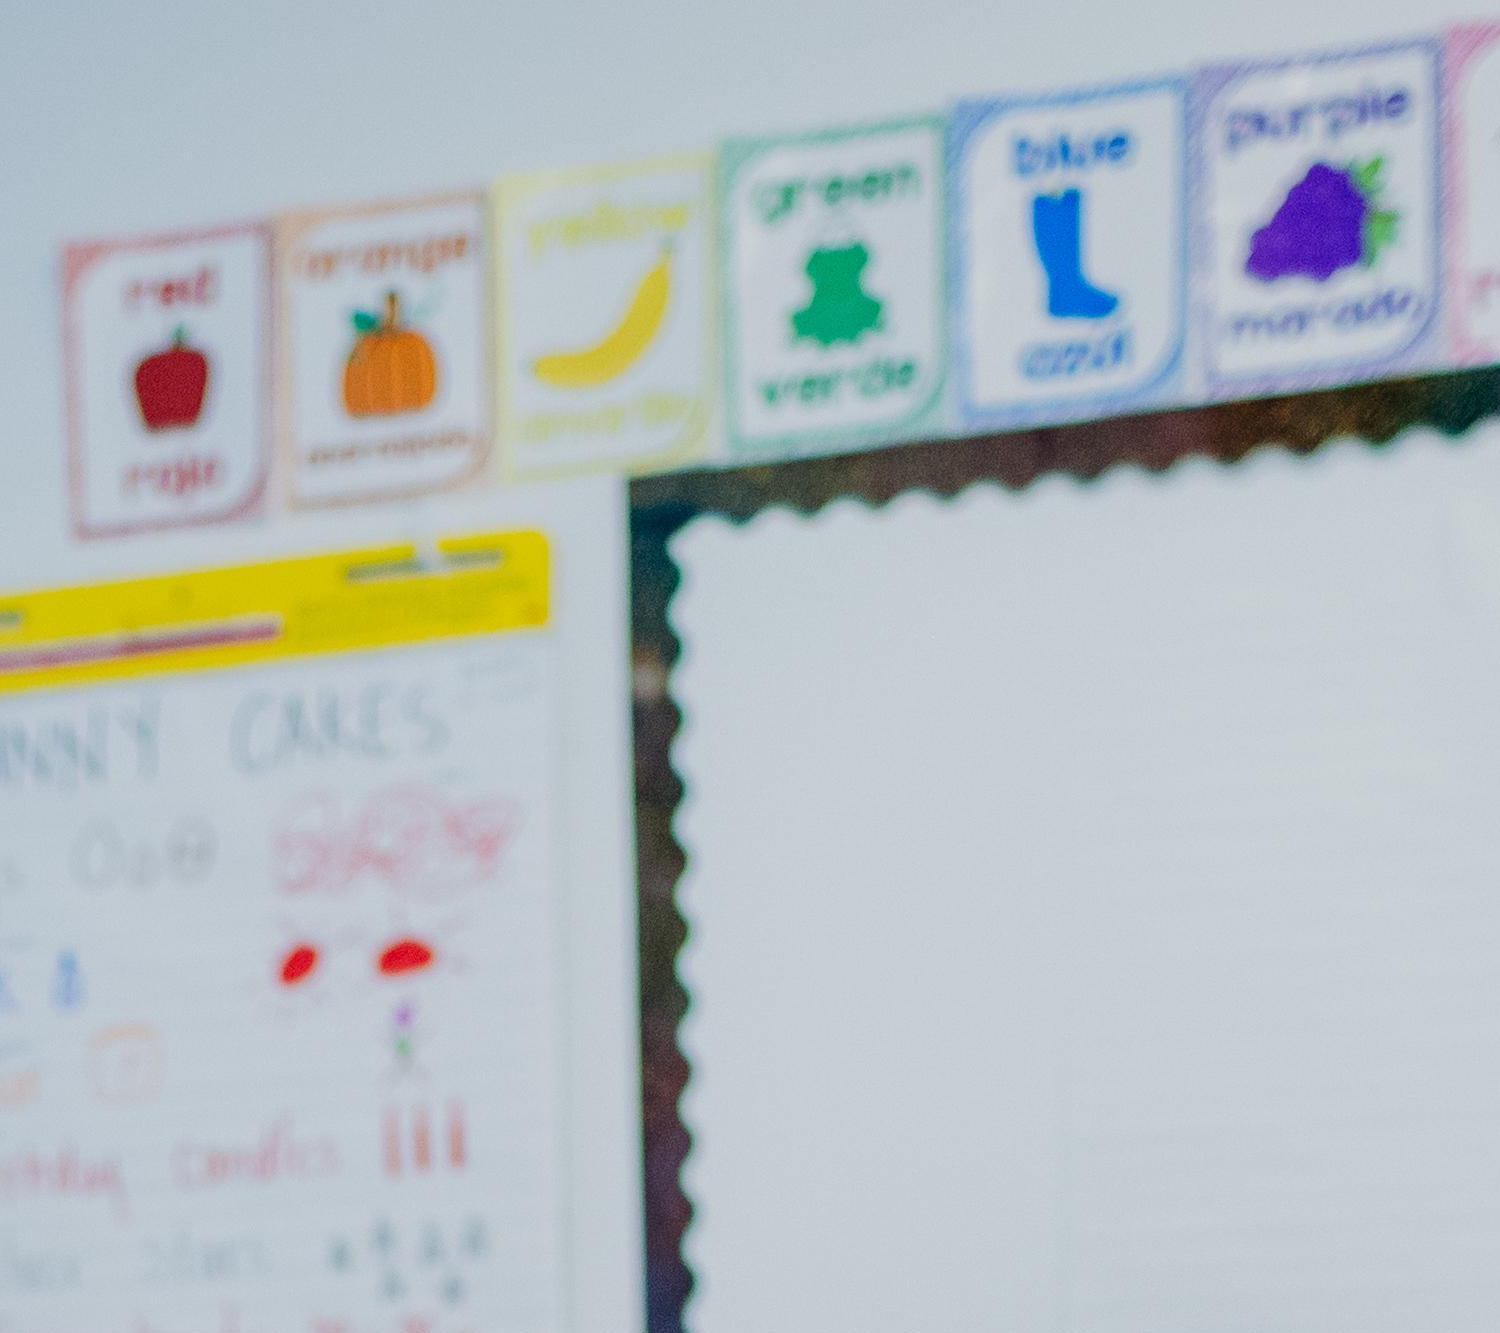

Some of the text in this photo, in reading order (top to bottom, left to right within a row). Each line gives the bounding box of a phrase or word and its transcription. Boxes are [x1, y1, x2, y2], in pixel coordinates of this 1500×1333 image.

[1227, 89, 1409, 153] purple
[1014, 130, 1132, 175] blue
[756, 165, 917, 227] green
[529, 197, 687, 259] yellow
[298, 232, 469, 282] orange
[122, 265, 215, 310] red
[1020, 331, 1128, 380] azul
[759, 358, 917, 407] verde
[124, 458, 219, 497] rojo
[229, 685, 449, 776] CAKES
